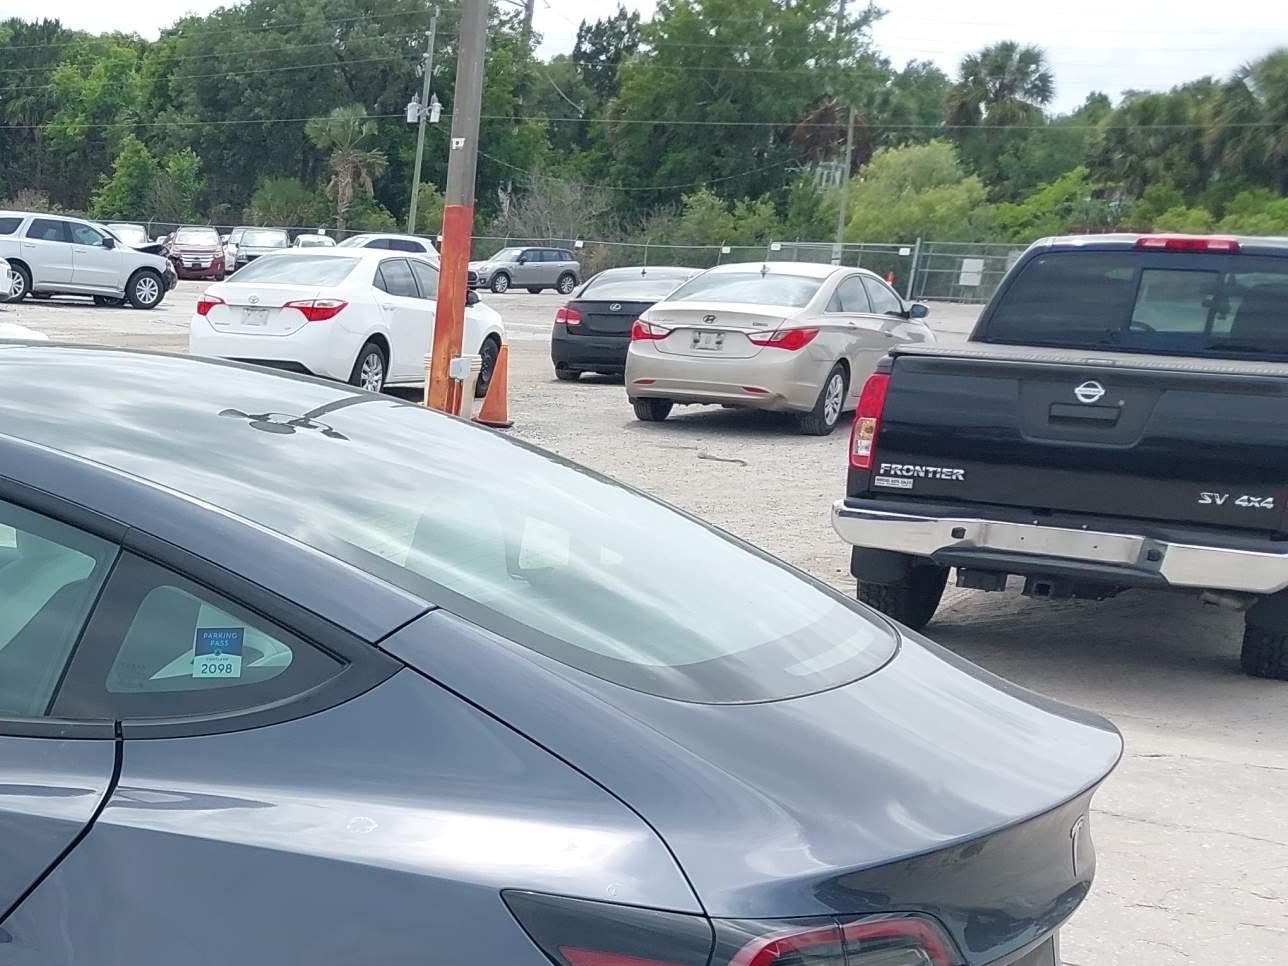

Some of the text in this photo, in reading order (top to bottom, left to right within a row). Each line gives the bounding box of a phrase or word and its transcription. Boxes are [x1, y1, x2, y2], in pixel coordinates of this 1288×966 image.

[879, 463, 965, 481] FRONTIER
[1198, 492, 1229, 505] SV
[201, 663, 233, 674] 2098
